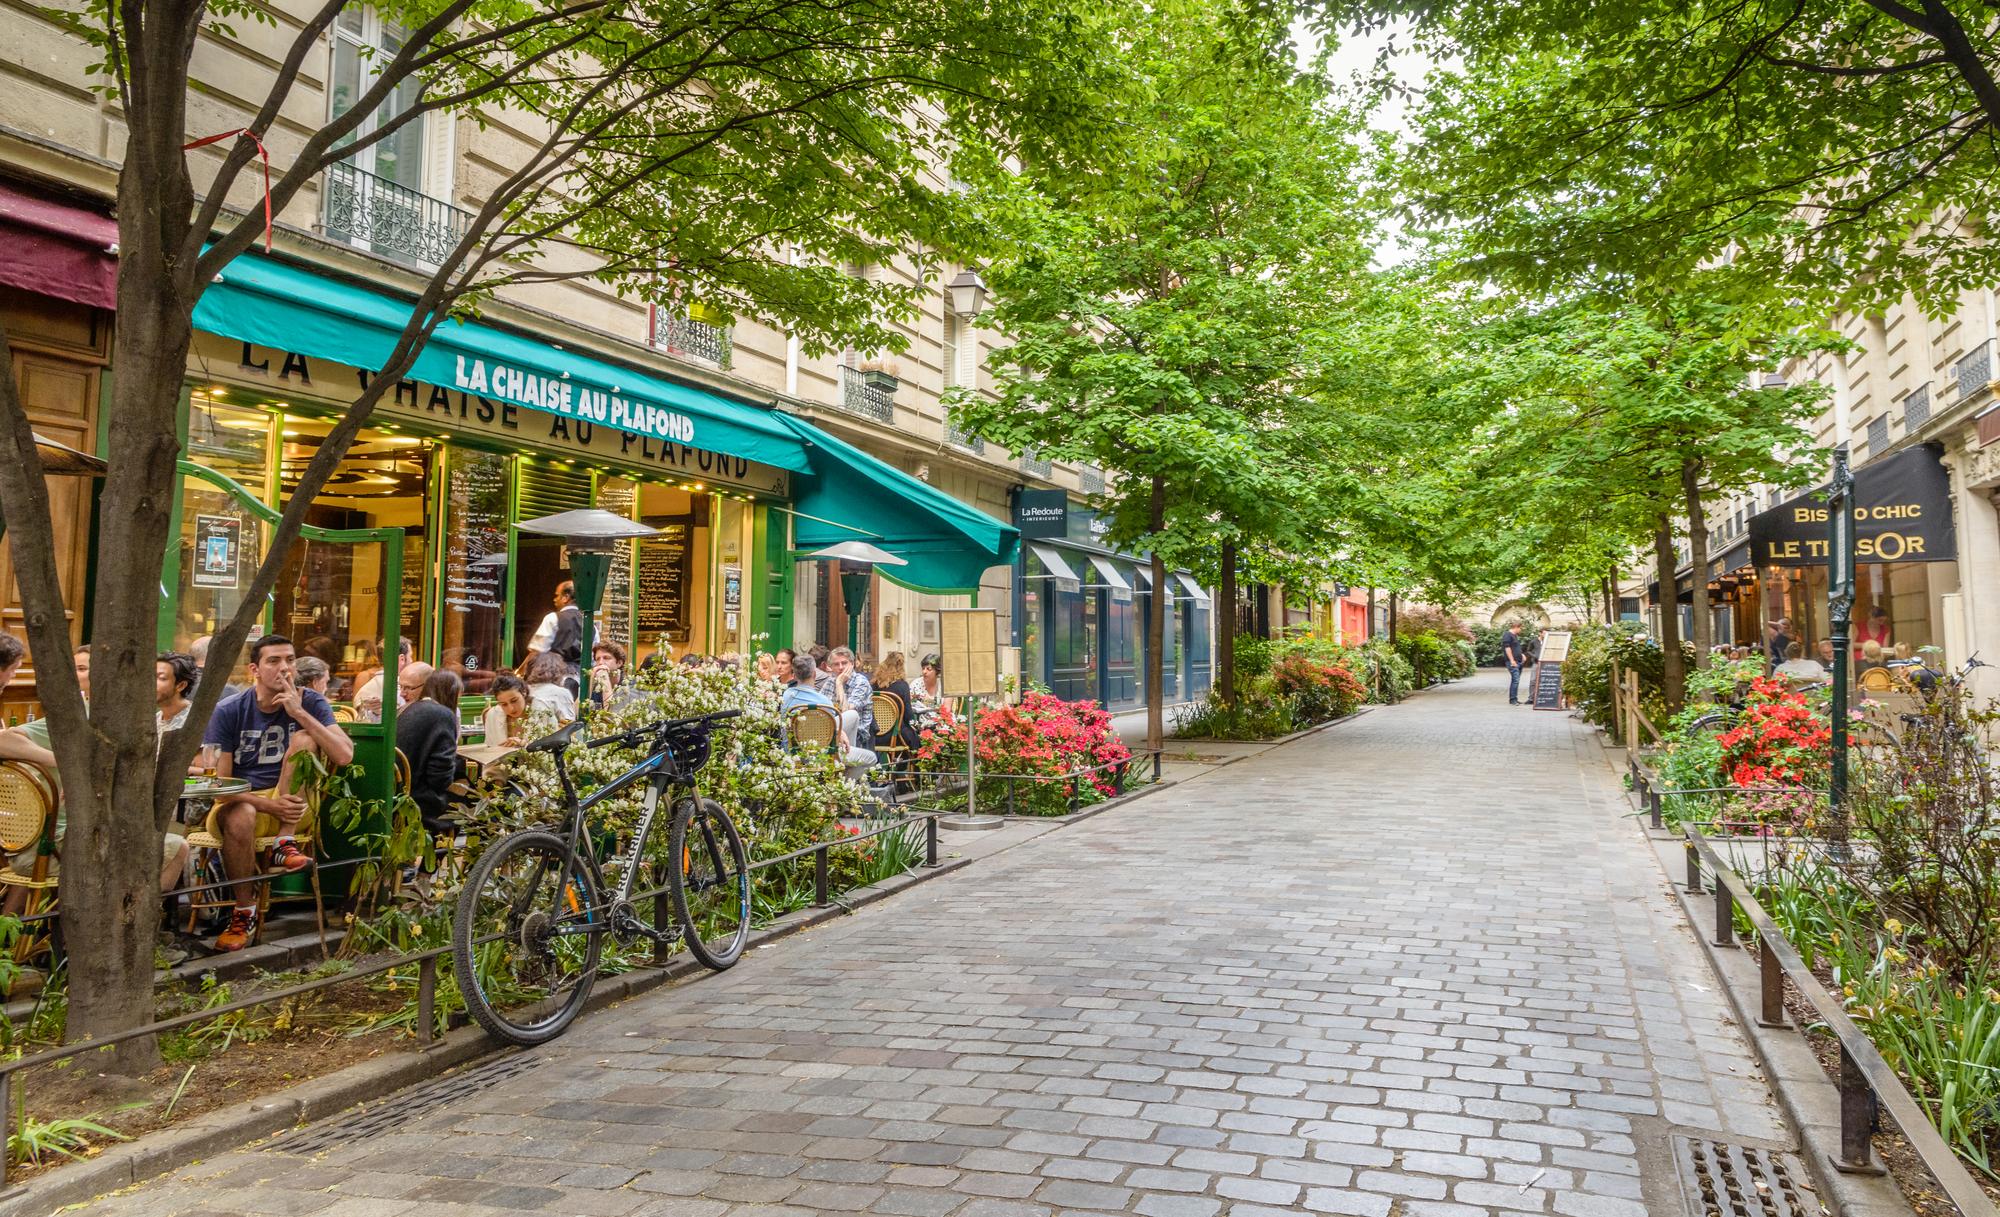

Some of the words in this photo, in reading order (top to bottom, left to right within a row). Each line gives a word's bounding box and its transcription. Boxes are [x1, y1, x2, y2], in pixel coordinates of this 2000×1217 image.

[357, 368, 519, 430] HAISE
[455, 355, 488, 394] LA
[492, 366, 572, 413] CHAISE
[578, 388, 607, 422] AU
[611, 396, 695, 443] PLAFOND
[1022, 508, 1031, 516] La
[1031, 507, 1063, 516] Redoute
[1794, 507, 1868, 523] BISO
[1872, 504, 1922, 520] CHIC
[1768, 540, 1801, 559] LE
[1805, 532, 1926, 560] TSOR
